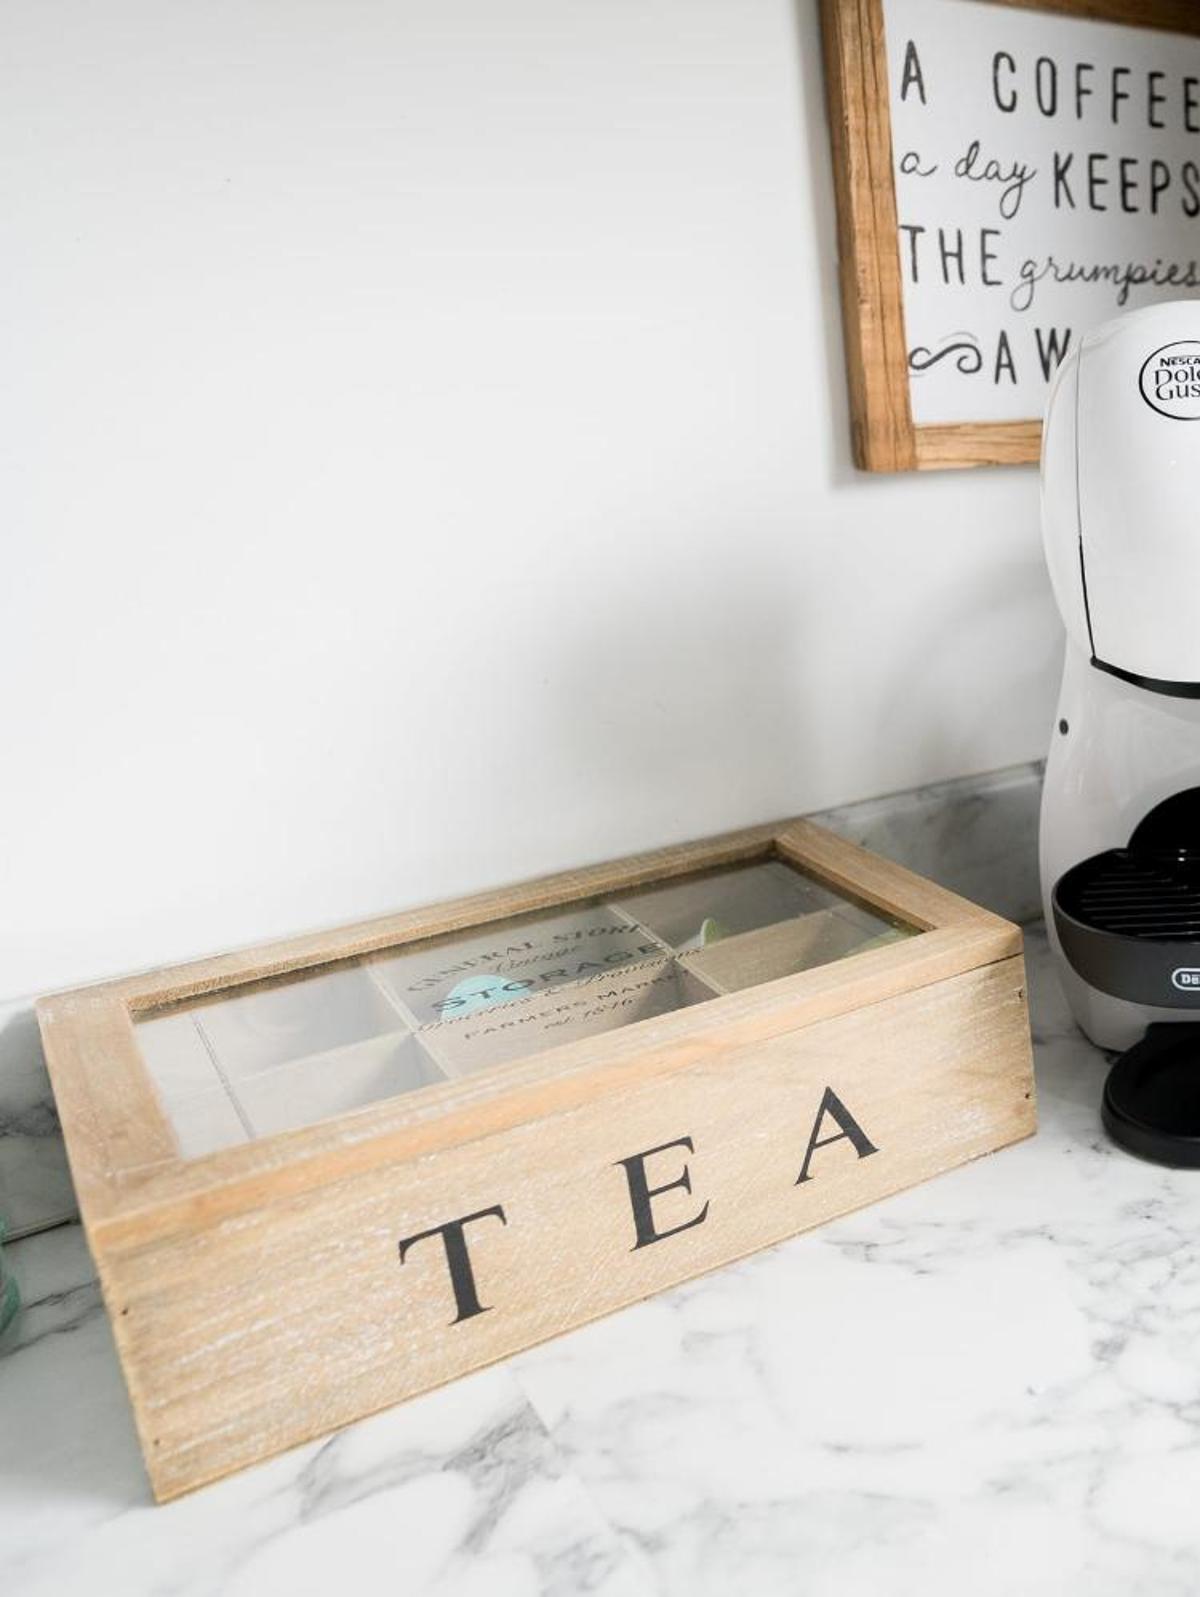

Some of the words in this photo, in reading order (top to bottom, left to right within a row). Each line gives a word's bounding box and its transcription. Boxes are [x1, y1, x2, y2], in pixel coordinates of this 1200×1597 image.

[901, 39, 927, 106] A
[900, 150, 938, 178] a
[954, 140, 1038, 220] day
[899, 223, 1003, 287] THE
[994, 327, 1072, 385] AW
[431, 941, 663, 1012] STORAGE
[398, 1085, 881, 1328] TEA
